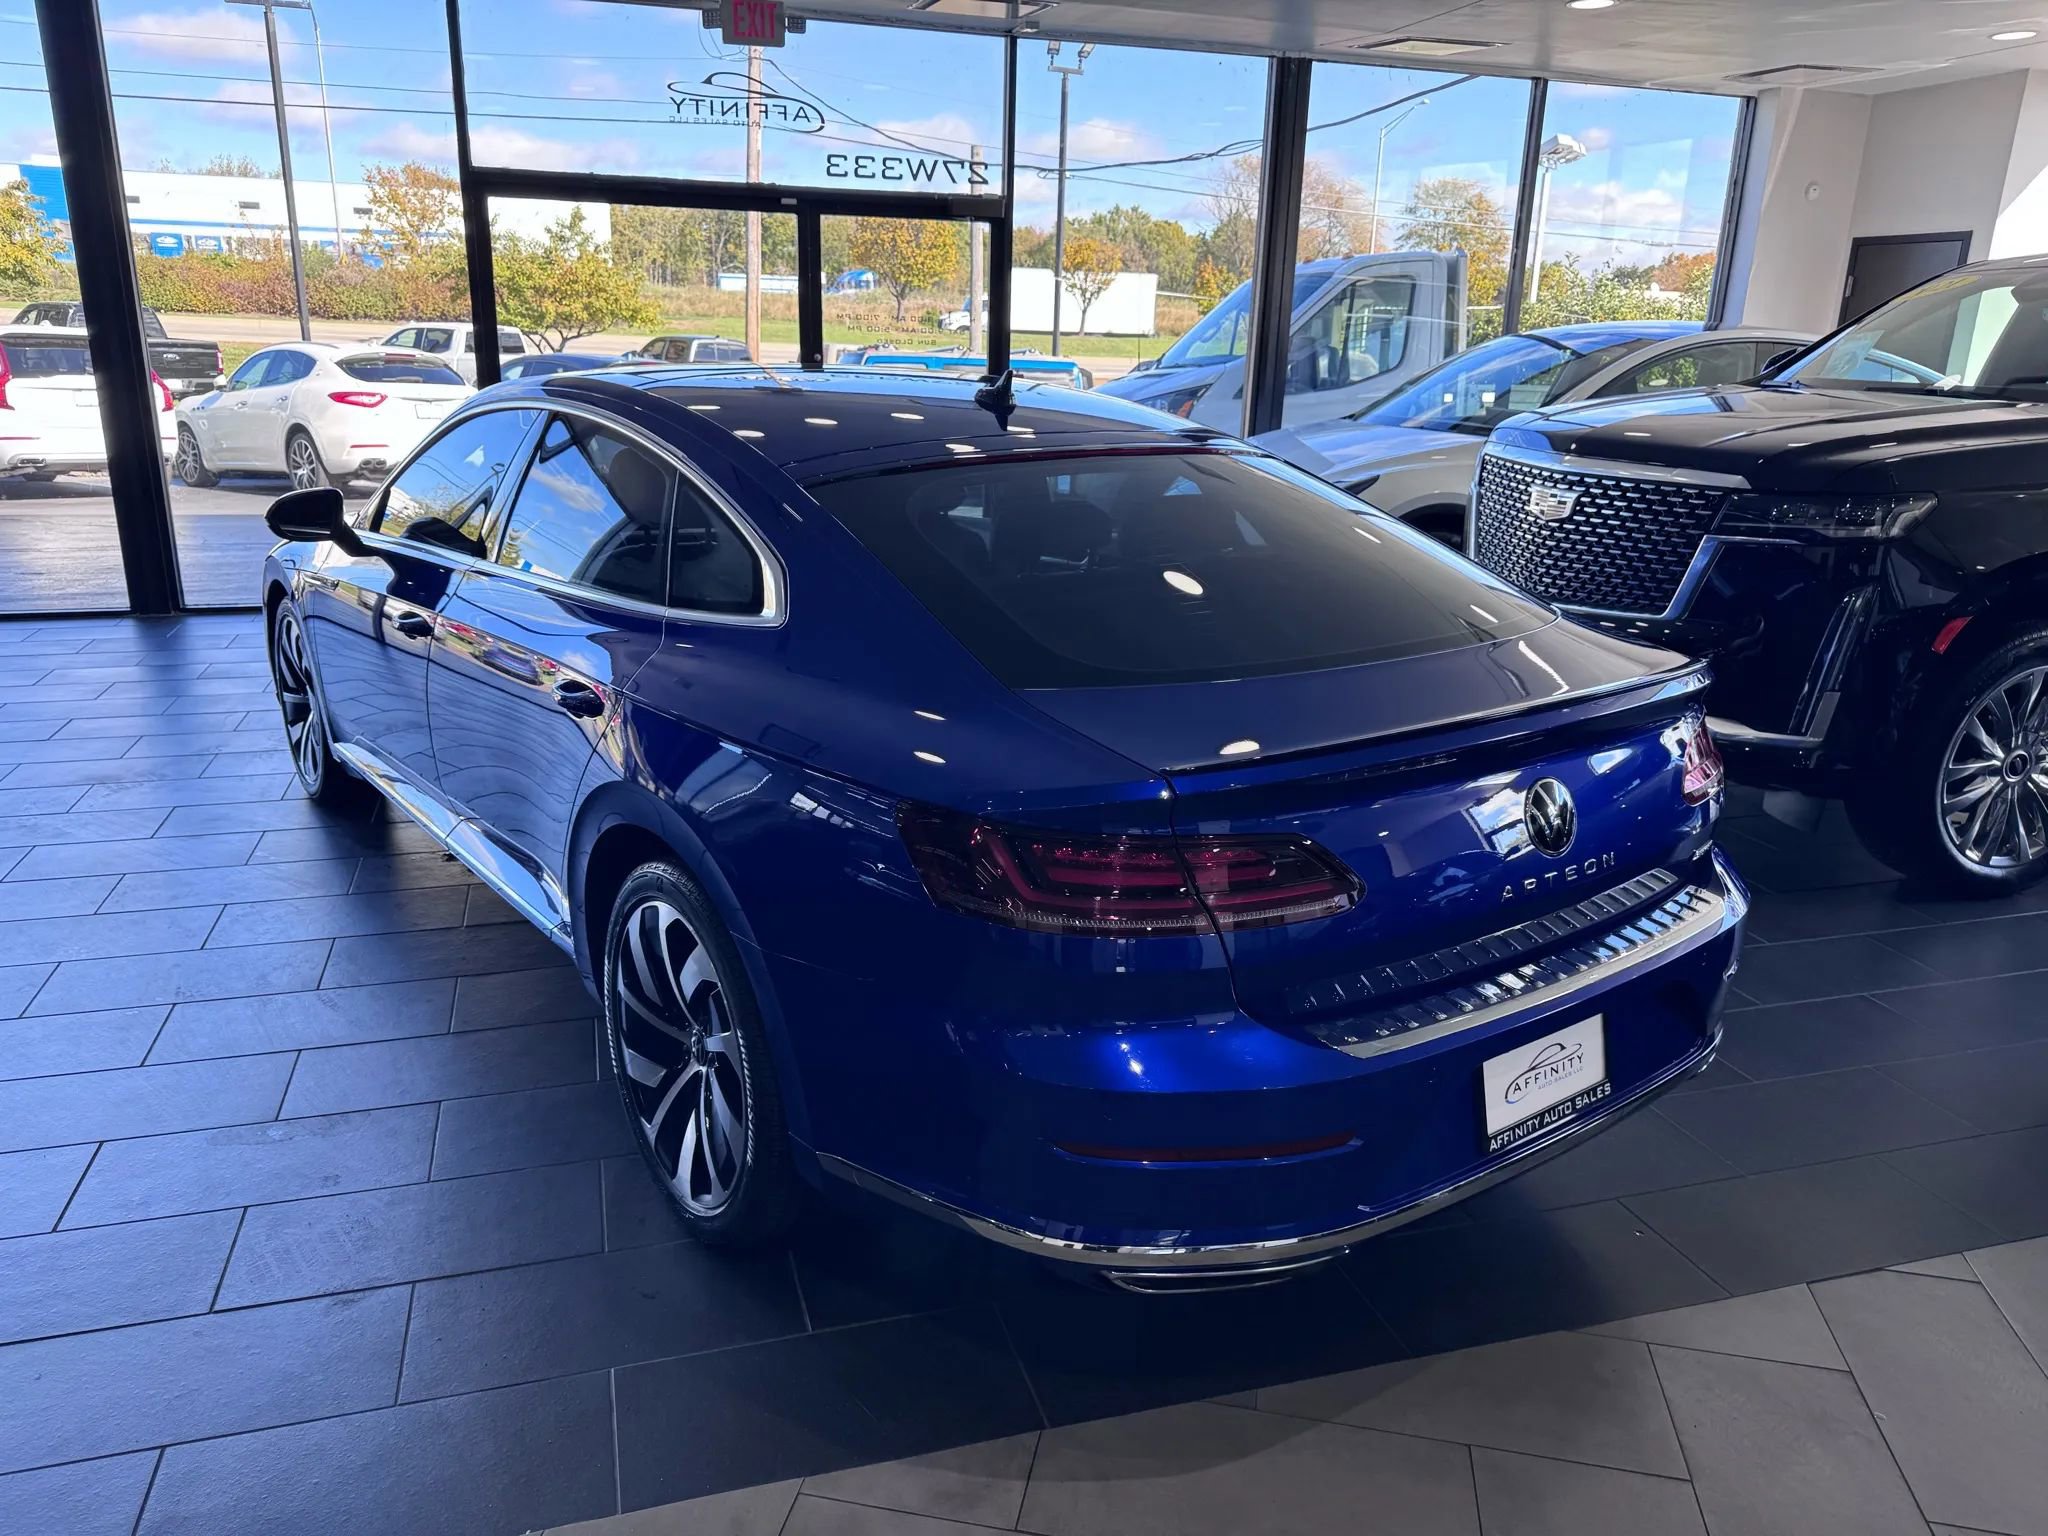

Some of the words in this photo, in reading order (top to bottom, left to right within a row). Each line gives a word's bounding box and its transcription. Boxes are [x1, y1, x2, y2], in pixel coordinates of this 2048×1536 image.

[732, 0, 777, 40] EXIT
[1502, 851, 1616, 902] ARTEON
[1512, 1052, 1584, 1094] AFFINITY
[1537, 1079, 1553, 1090] AUTO
[1554, 1071, 1573, 1083] SALES
[1489, 1116, 1541, 1152] AFFINITY
[1543, 1101, 1573, 1126] AUTO
[1575, 1082, 1612, 1109] SALES
